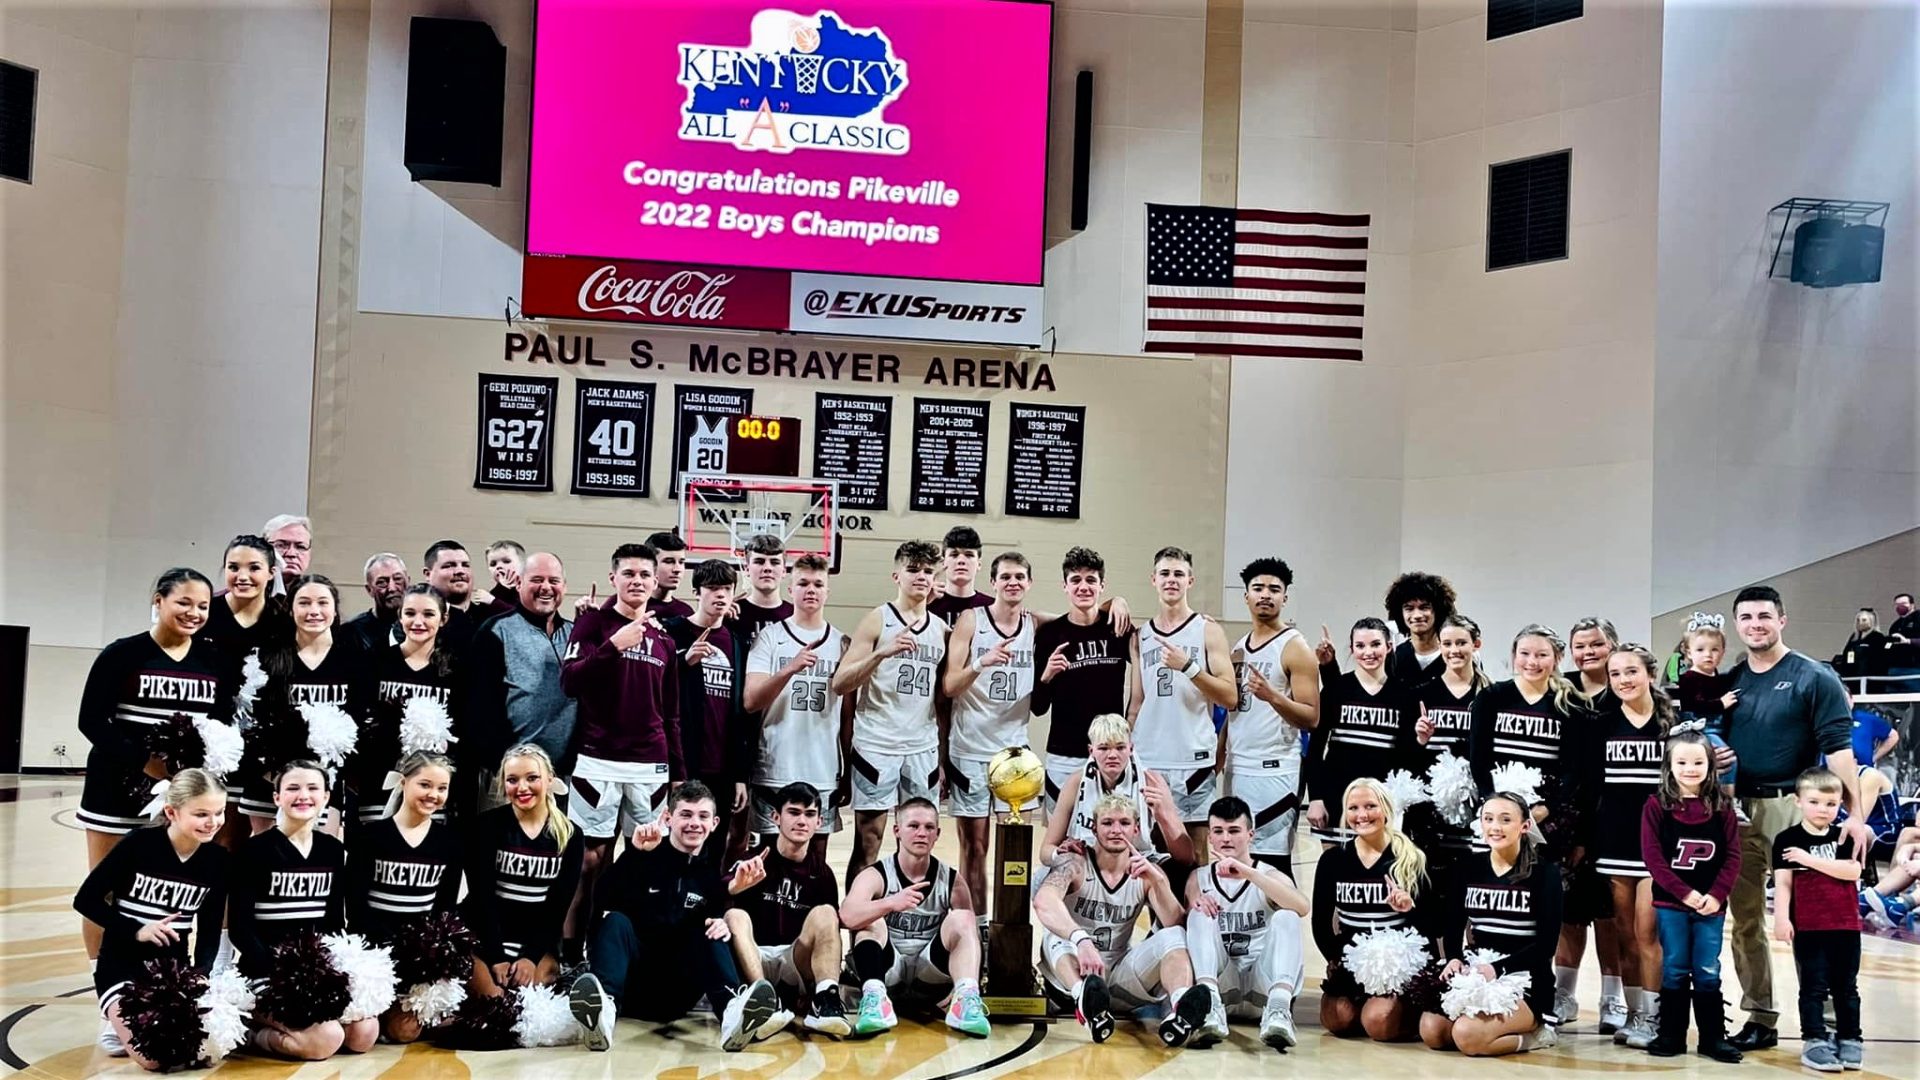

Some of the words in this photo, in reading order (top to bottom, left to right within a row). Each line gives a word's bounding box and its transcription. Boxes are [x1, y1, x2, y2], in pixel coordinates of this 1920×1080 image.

[683, 114, 737, 138] ALL
[789, 121, 905, 150] CLASSIC
[622, 160, 841, 199] Congratulations
[847, 176, 960, 208] Pikeville
[639, 200, 712, 229] 2022
[717, 205, 785, 240] Boys
[790, 210, 941, 246] Champions
[577, 264, 736, 321] Coca-Cola
[503, 332, 606, 367] PAUL
[629, 339, 665, 370] S.
[688, 343, 901, 383] McBRAYER
[923, 356, 1057, 392] ARENA
[489, 382, 509, 393] GERI
[511, 384, 547, 395] POLVINO
[586, 387, 611, 398] JACK
[612, 388, 645, 401] ADAMS
[685, 393, 706, 403] LISA
[708, 394, 741, 406] GOODIN
[821, 398, 842, 409] MEN'S
[843, 400, 887, 412] BASKETBALL
[919, 404, 940, 414] MEN'S
[941, 405, 984, 417] BASKETBALL
[1042, 410, 1079, 423] BASKETBALL
[488, 418, 545, 450] 627
[737, 418, 781, 441] 00.0
[929, 416, 974, 428] 2004-2005
[588, 418, 636, 457] 40
[497, 451, 534, 463] WINS
[696, 447, 724, 471] 20
[488, 467, 539, 481] 1966-1997
[586, 472, 636, 487] 1953-1956
[137, 674, 217, 705] PIKEVILLE
[896, 663, 930, 697] 24
[988, 671, 1017, 702] 21
[1156, 666, 1174, 698] 2
[791, 680, 827, 712] 25
[1494, 711, 1562, 741] PIKEVILLE
[1670, 838, 1716, 870] P
